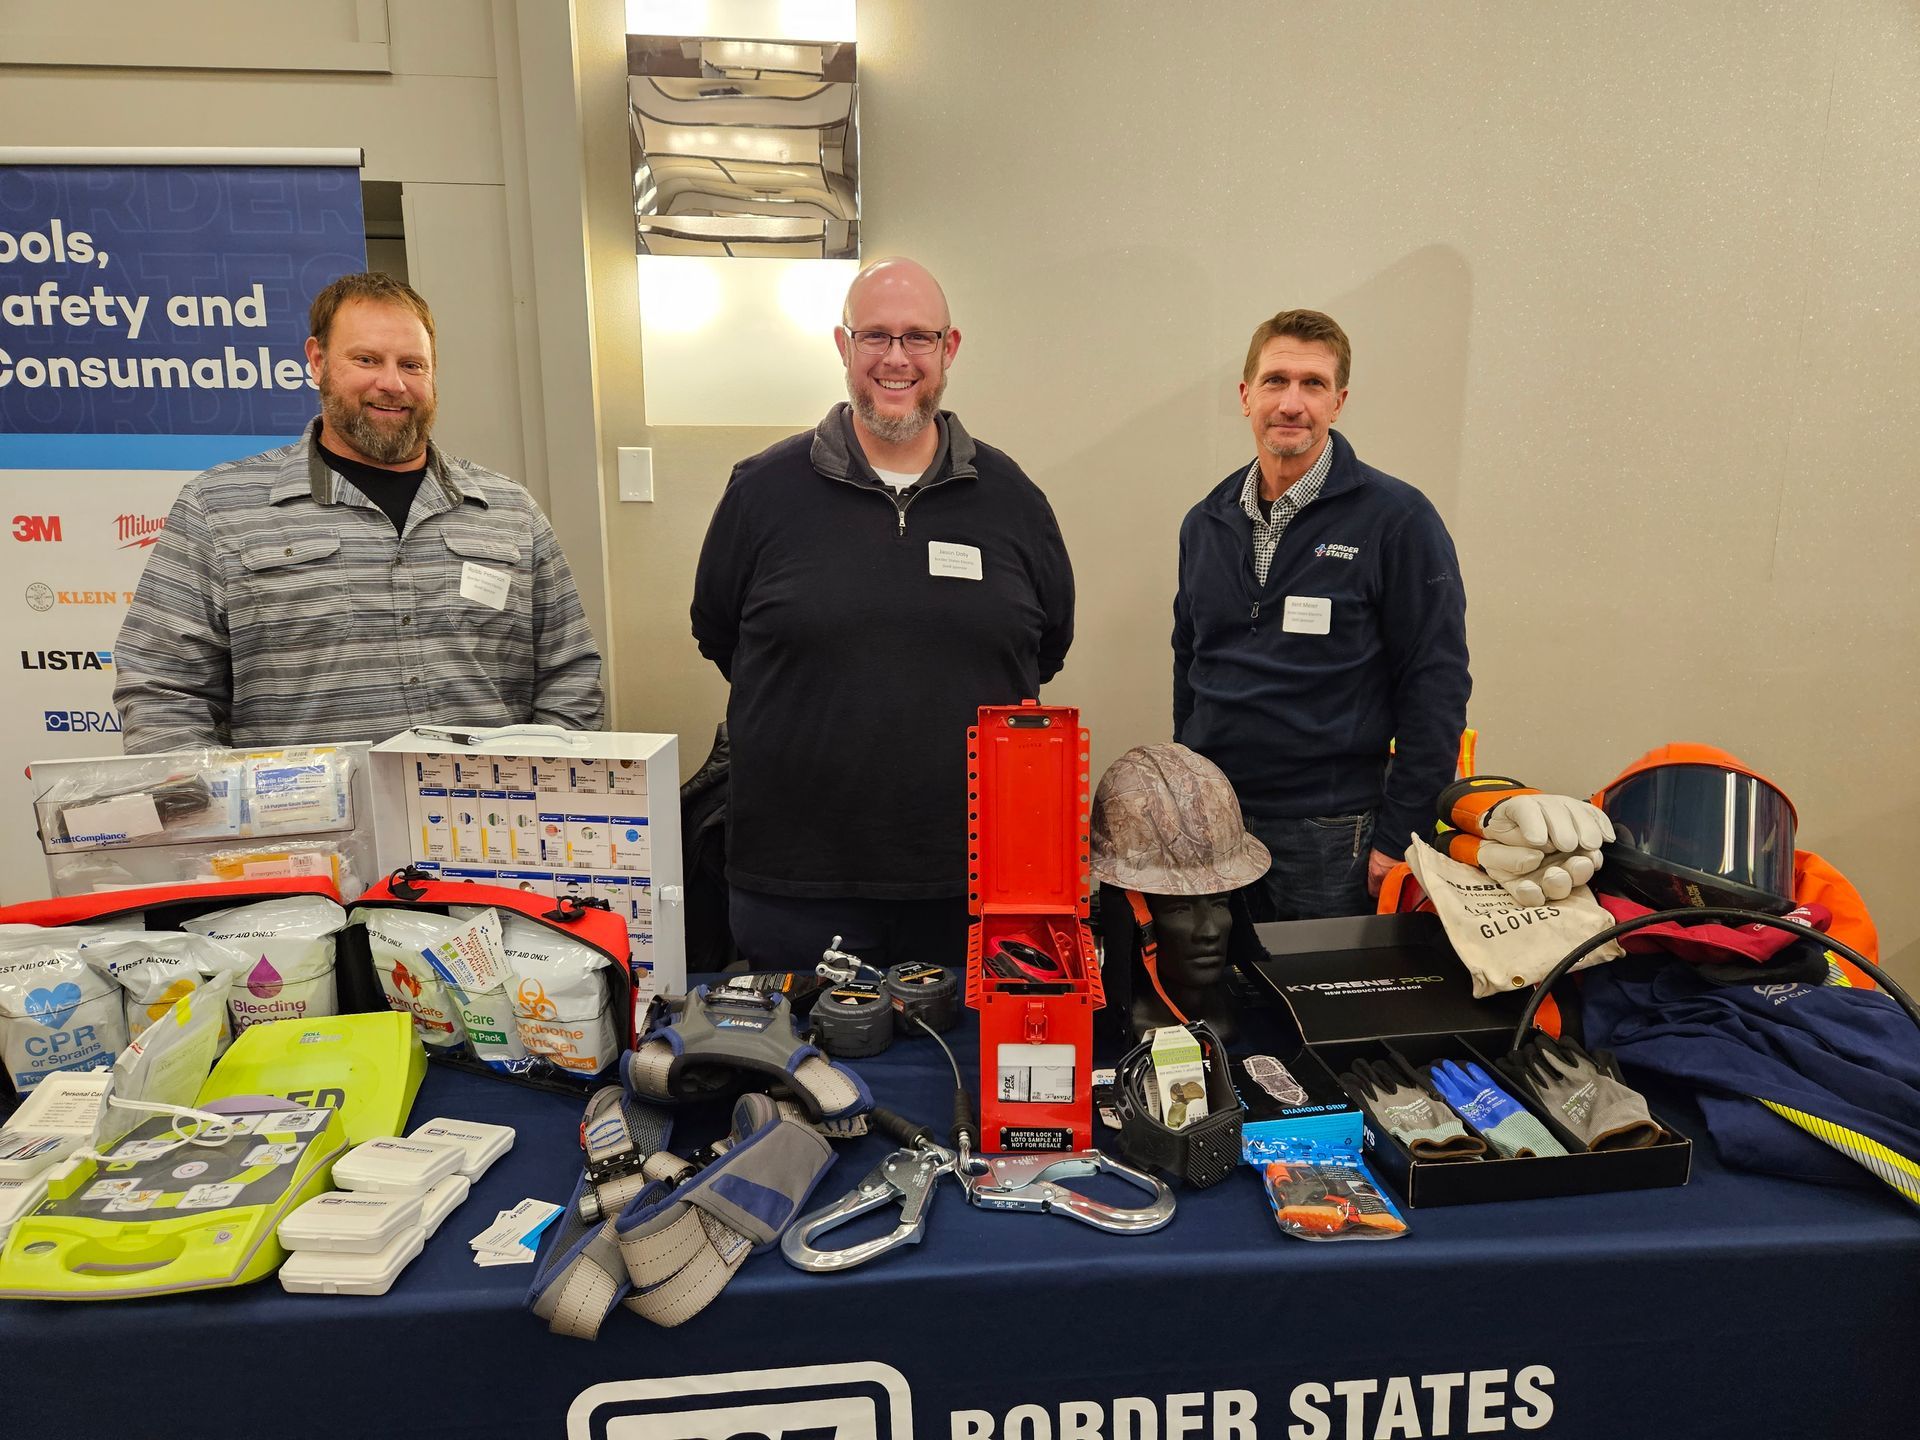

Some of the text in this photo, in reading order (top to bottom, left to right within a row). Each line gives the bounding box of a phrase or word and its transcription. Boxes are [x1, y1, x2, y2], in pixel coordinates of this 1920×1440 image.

[0, 219, 109, 268] ools,
[2, 282, 268, 339] afety and
[12, 515, 63, 542] 3M
[1325, 549, 1354, 560] STATES
[1327, 543, 1359, 554] BORDER
[58, 591, 117, 605] KLEIN
[21, 650, 103, 671] LISTA
[1480, 906, 1561, 939] GLOVES
[453, 936, 486, 987] First Aid Kit
[465, 941, 485, 974] Module
[517, 951, 529, 959] AID
[117, 958, 145, 974] FIRST
[1398, 975, 1445, 985] PRO
[233, 999, 307, 1014] Bleeding
[385, 993, 444, 1019] Burn Care
[1774, 988, 1812, 1006] 40 CAL
[463, 1010, 495, 1026] Care
[25, 1024, 97, 1057] CPR
[478, 1032, 502, 1042] Pack
[31, 1042, 102, 1068] or Sprains
[1281, 1103, 1348, 1115] DIAMOND GRIP
[1288, 1364, 1555, 1440] STATES
